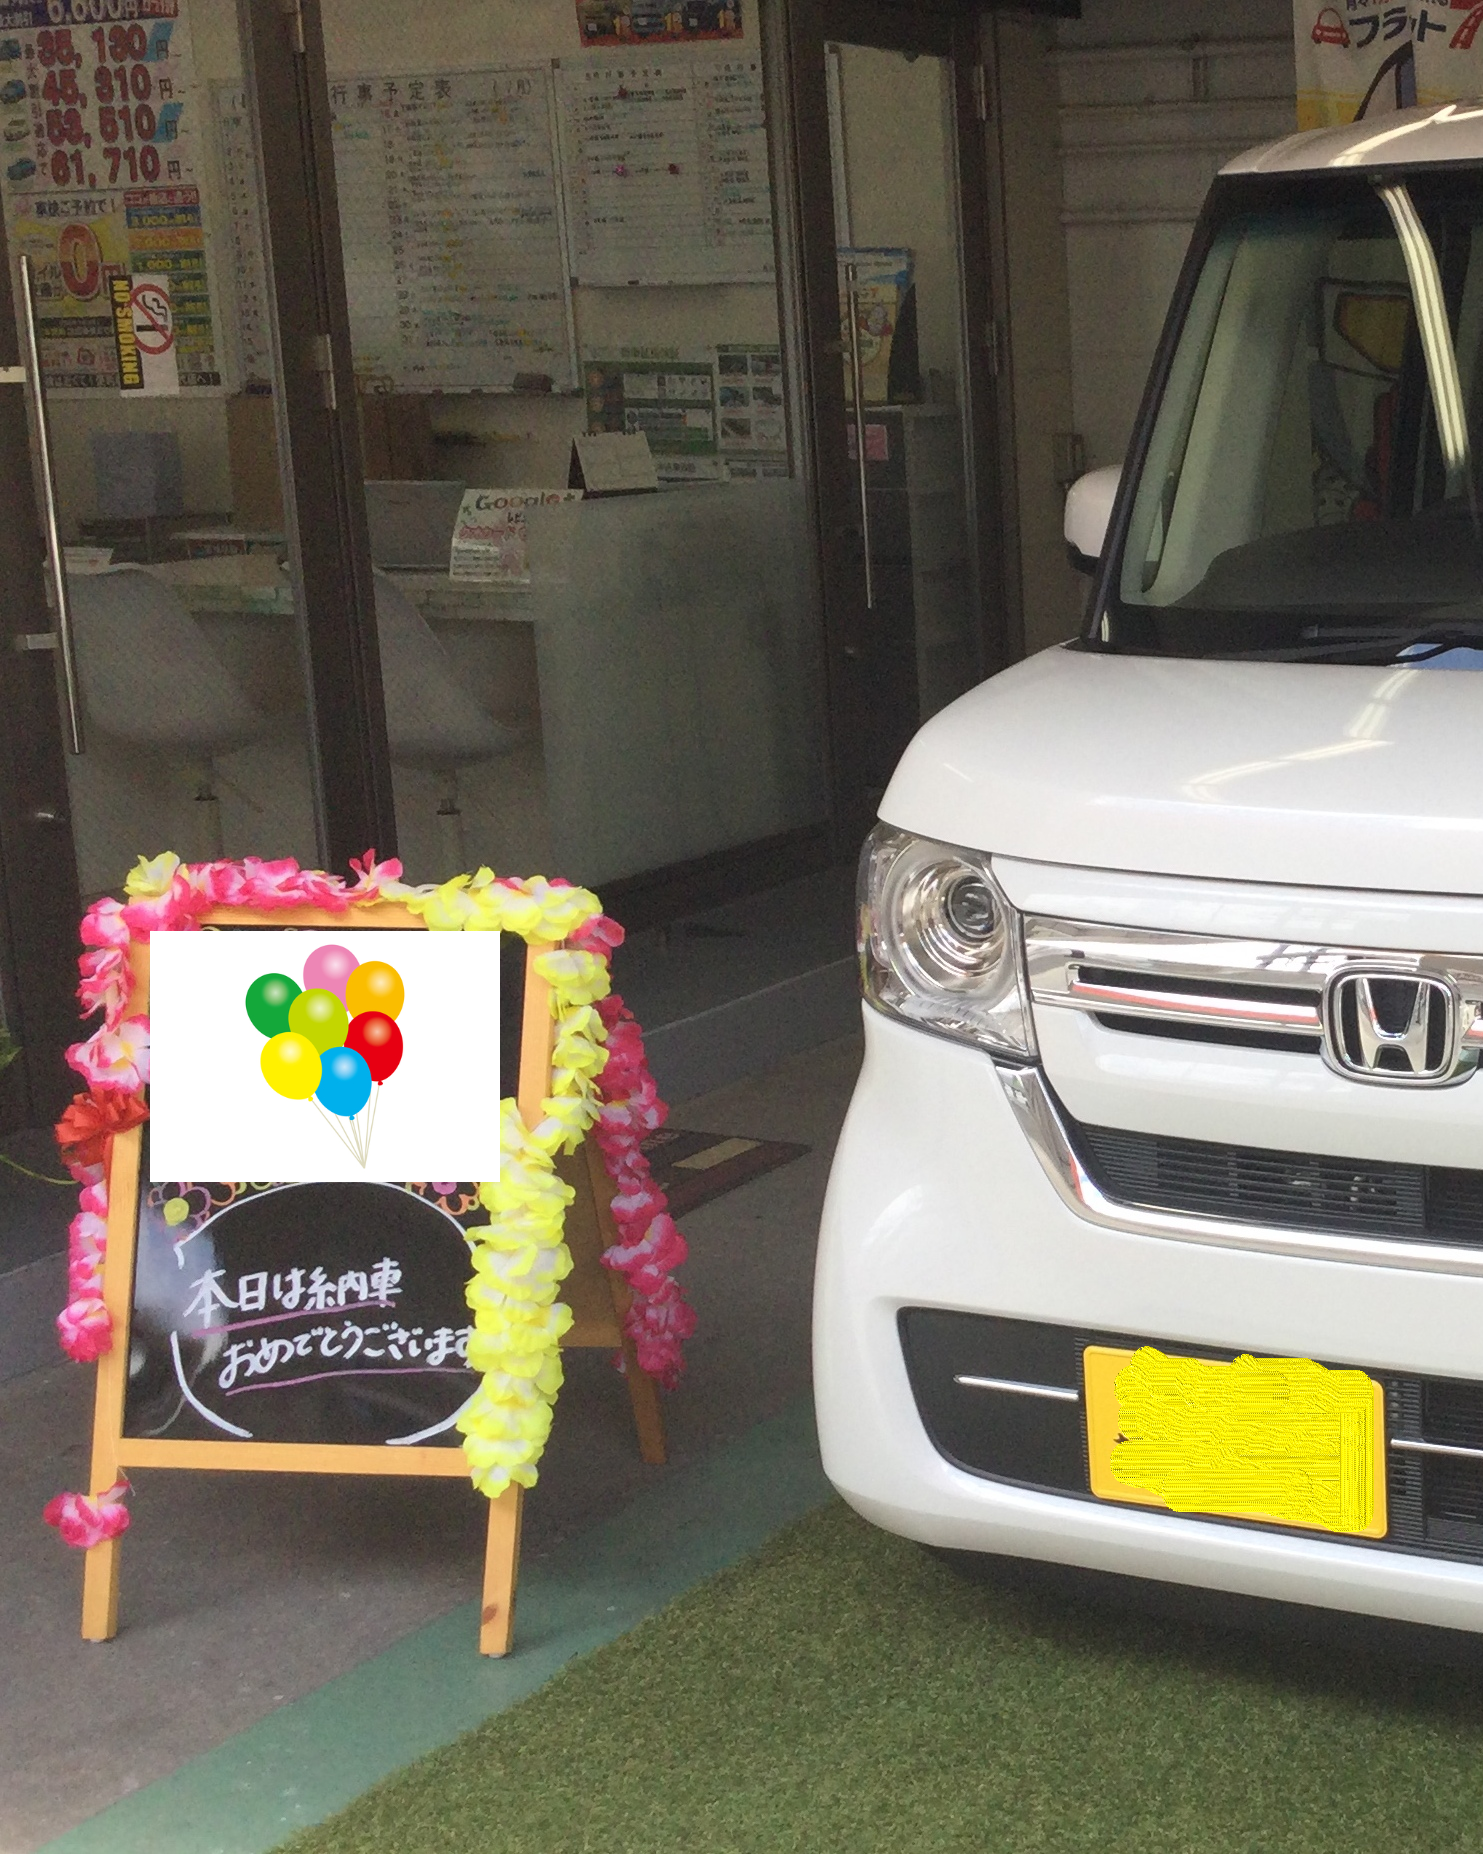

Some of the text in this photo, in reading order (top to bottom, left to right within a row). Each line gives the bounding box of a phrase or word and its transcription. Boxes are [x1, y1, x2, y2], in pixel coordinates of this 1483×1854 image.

[113, 280, 140, 385] NO SMOKING
[183, 1257, 403, 1328] 本日は納車
